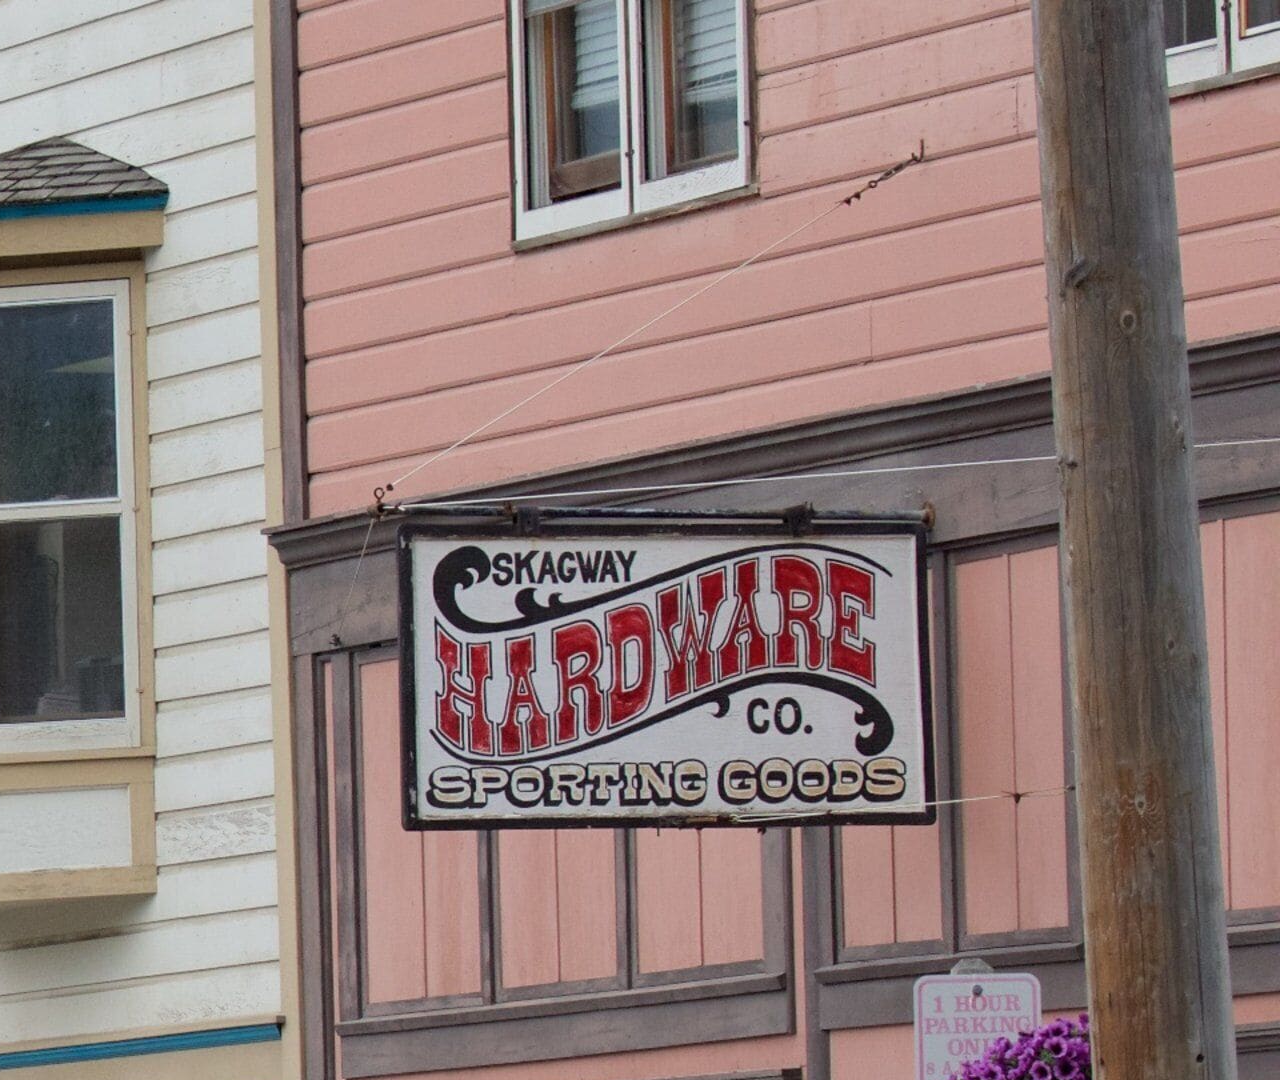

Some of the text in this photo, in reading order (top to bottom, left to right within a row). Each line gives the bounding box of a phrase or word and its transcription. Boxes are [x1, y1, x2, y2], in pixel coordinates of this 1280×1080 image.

[491, 549, 638, 586] SKAGWAY
[434, 554, 877, 758] HARDWARE
[746, 697, 813, 735] CO.
[427, 757, 907, 808] SPORTING GOODS
[933, 993, 1021, 1013] 1 HOUR
[923, 1016, 1031, 1036] PARKING
[948, 1038, 991, 1057] ONL
